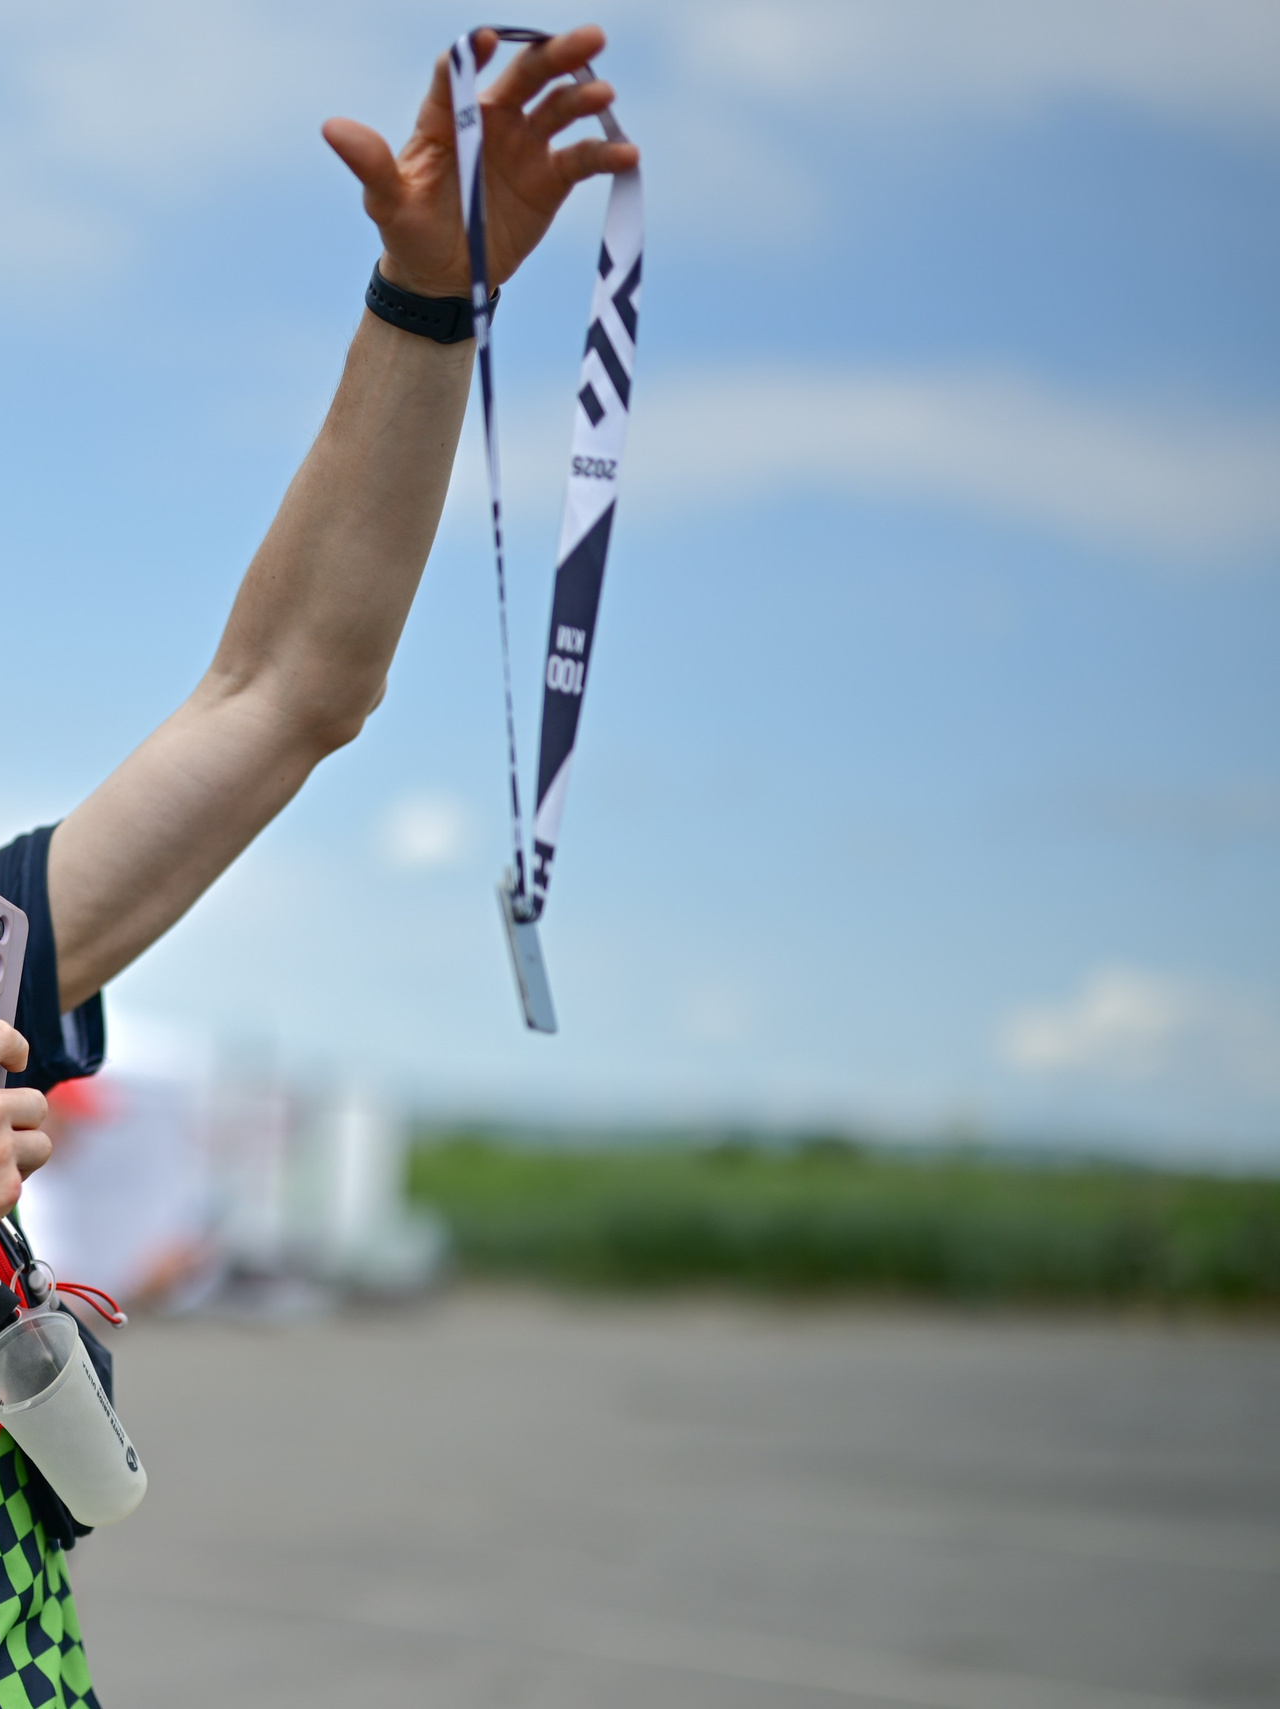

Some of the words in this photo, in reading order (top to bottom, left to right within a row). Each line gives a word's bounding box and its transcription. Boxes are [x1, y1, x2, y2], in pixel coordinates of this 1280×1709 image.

[572, 455, 617, 480] 2025
[556, 625, 586, 655] KM
[546, 654, 585, 696] 100
[81, 1360, 97, 1390] ULTRA
[96, 1389, 111, 1418] BRIDE
[110, 1416, 125, 1448] WHITE
